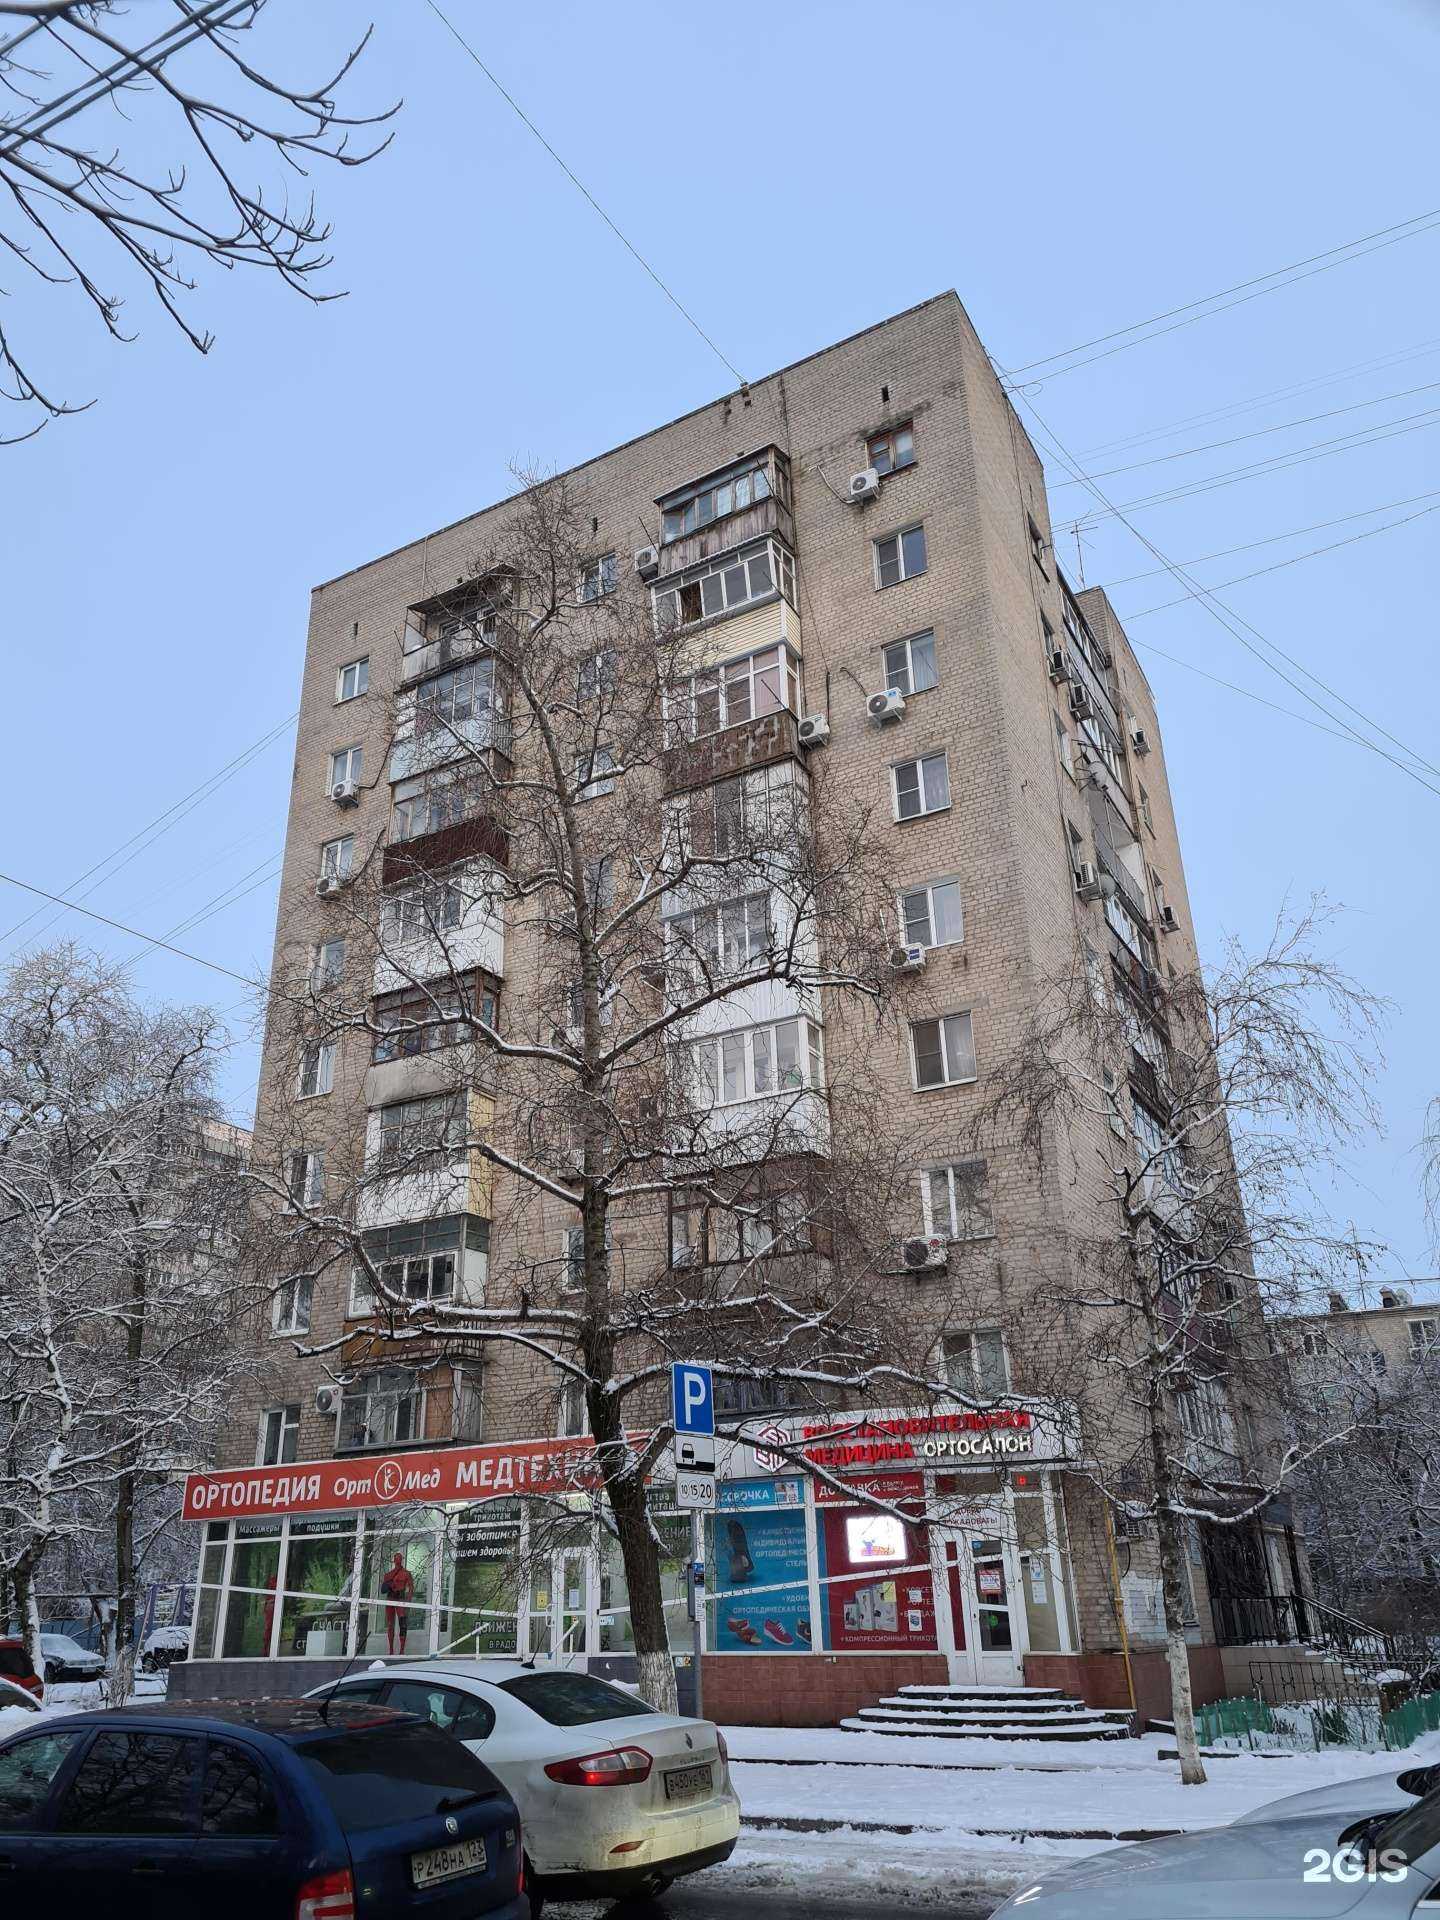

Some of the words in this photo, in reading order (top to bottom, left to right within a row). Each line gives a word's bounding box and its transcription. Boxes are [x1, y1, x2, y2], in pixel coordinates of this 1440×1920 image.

[684, 1372, 706, 1424] P
[924, 1434, 1032, 1457] ОРТОСАЛОН
[191, 1474, 321, 1510] ОРТОПЕДИЯ
[403, 1467, 441, 1490] Мед
[681, 1484, 688, 1493] 10
[691, 1484, 698, 1496] 15
[700, 1484, 712, 1498] 20
[306, 1522, 340, 1534] подушки
